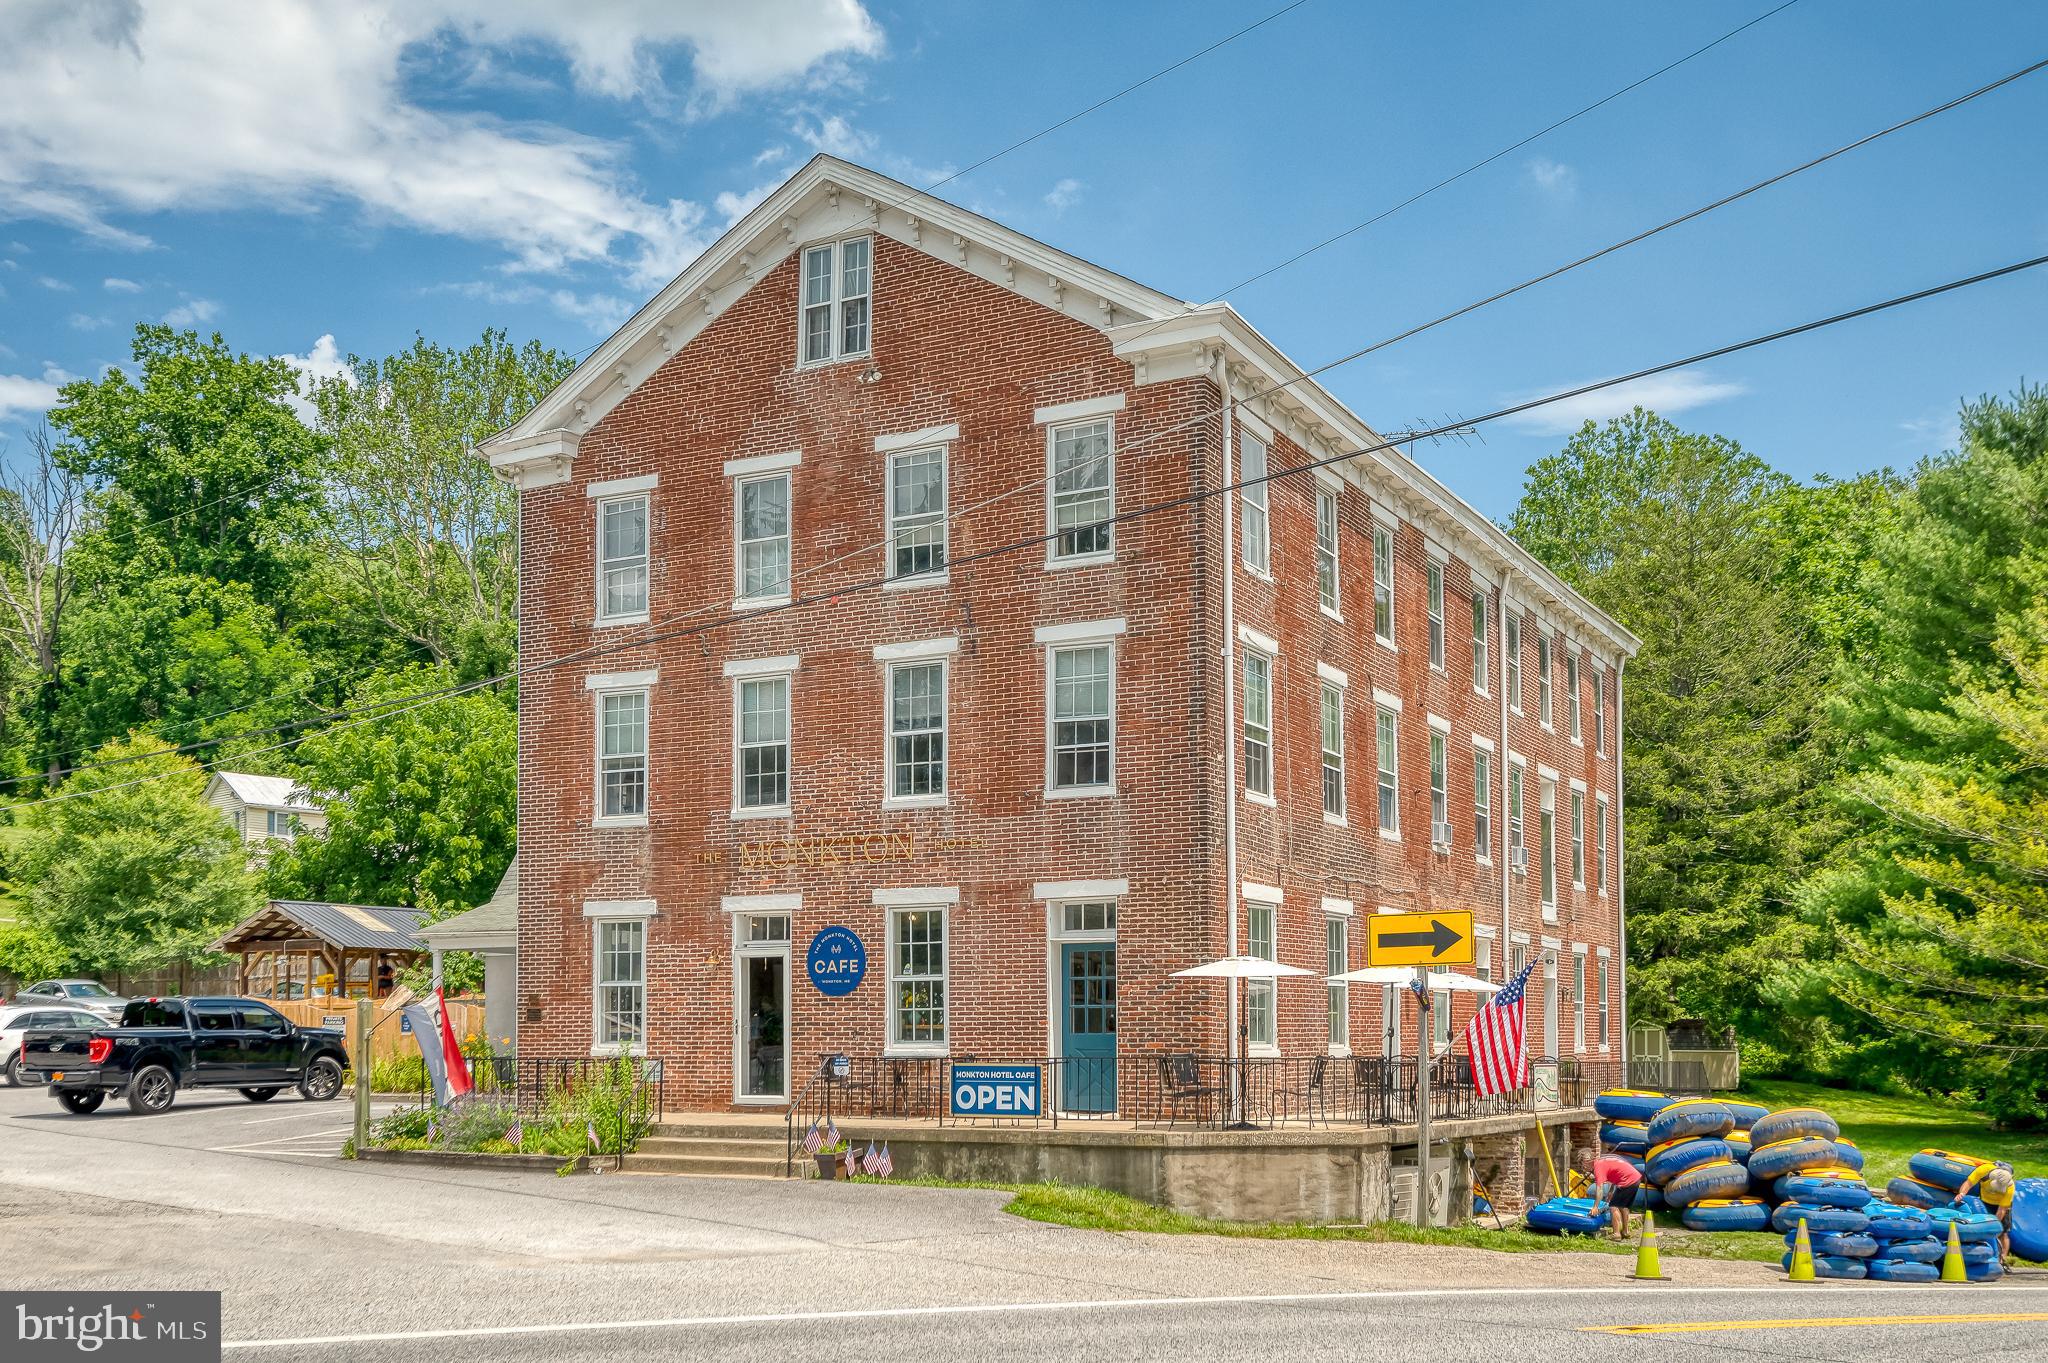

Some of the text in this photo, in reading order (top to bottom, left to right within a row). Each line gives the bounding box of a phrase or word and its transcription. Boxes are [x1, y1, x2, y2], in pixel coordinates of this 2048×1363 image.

[694, 832, 989, 870] THE MONKTON HOTEL
[814, 932, 859, 954] THE MONKTON HOTEL
[814, 959, 859, 974] CAFE
[955, 1070, 1035, 1079] MONKTON HOTEL CAFE
[955, 1084, 1035, 1111] OPEN
